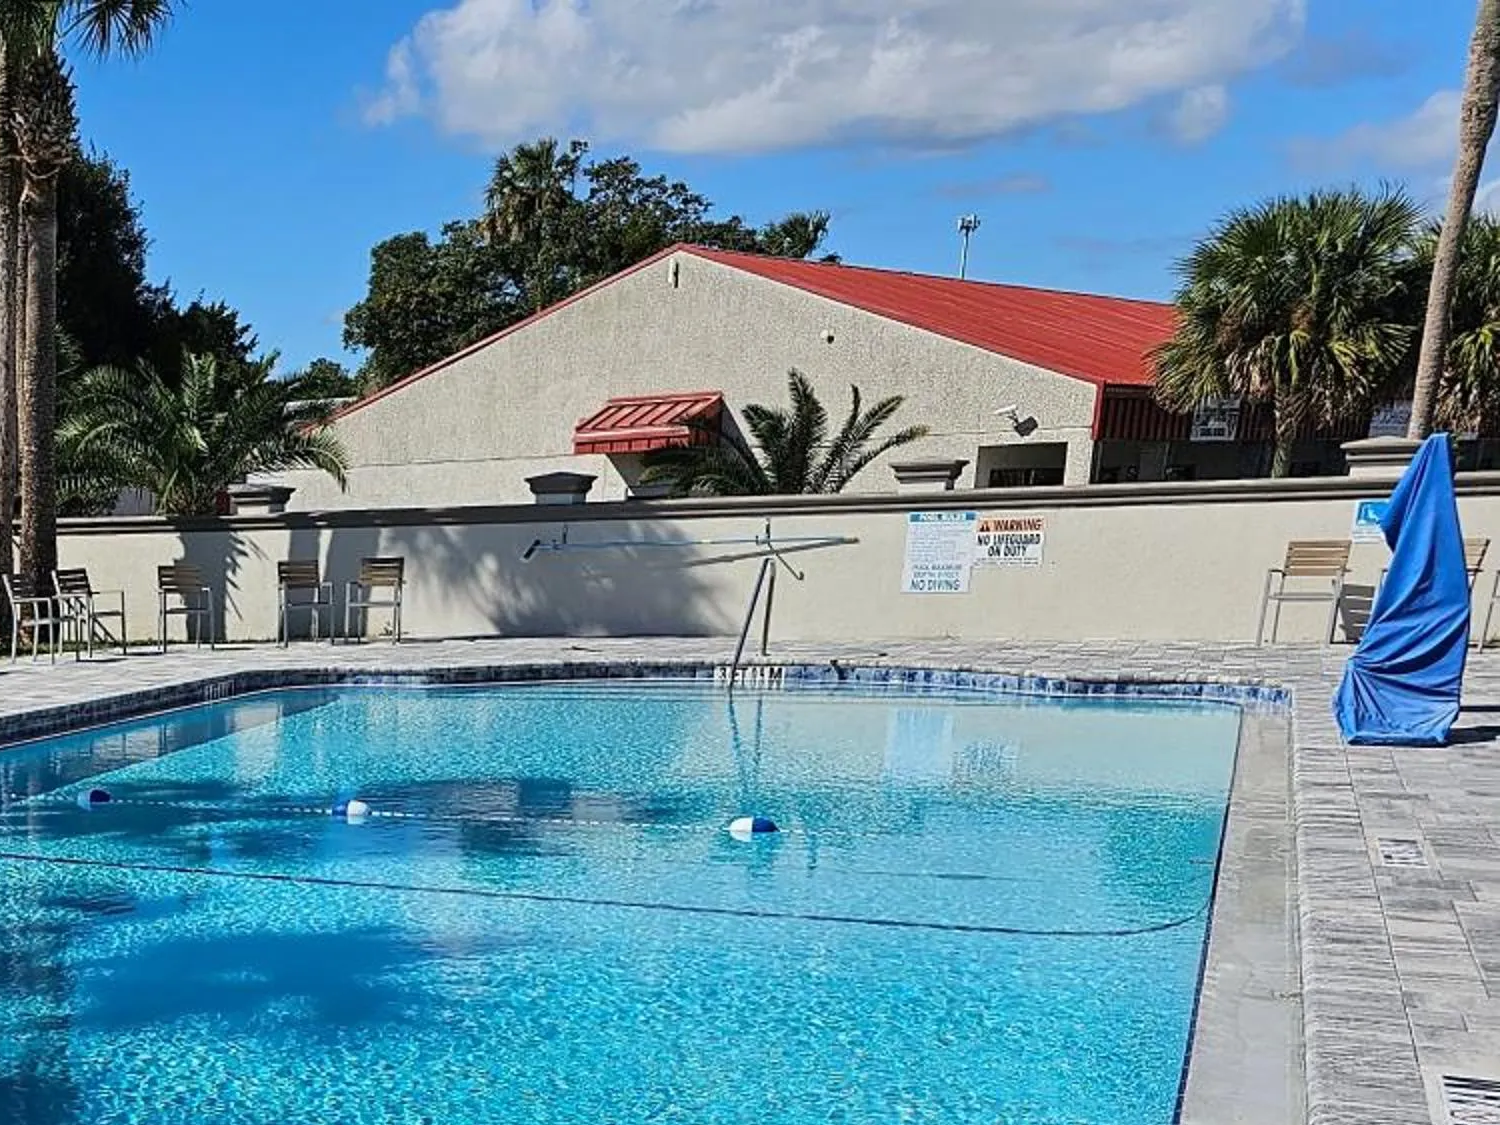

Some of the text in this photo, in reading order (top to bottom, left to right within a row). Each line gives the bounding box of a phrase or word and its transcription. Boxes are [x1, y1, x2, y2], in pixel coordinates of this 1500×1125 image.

[994, 519, 1041, 531] WARNING
[978, 533, 1040, 546] NO LIFEGUARD
[987, 545, 1027, 557] ON DUTY
[910, 579, 960, 591] NO DIVING
